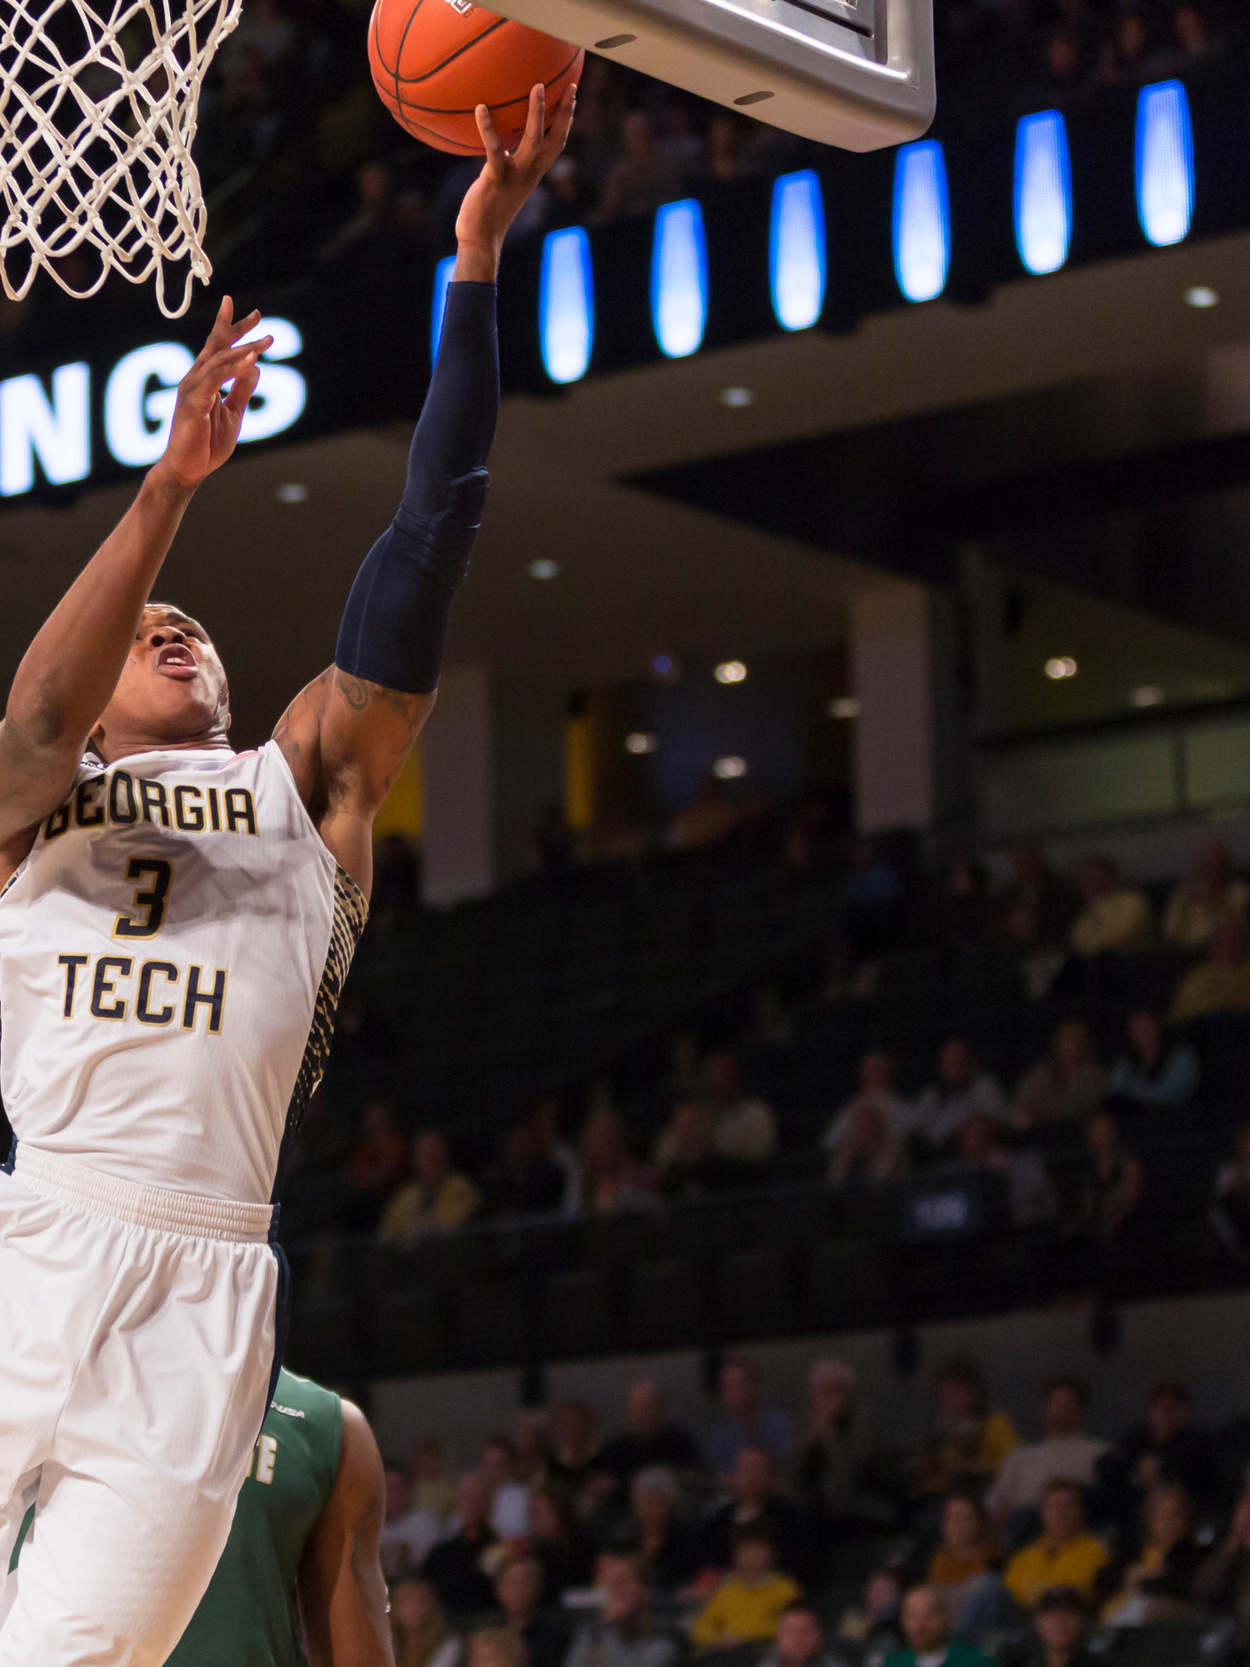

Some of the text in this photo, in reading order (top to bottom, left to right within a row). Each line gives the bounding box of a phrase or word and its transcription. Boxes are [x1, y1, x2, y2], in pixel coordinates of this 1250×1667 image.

[111, 856, 173, 939] 3
[57, 954, 228, 1035] TECH
[247, 1435, 277, 1484] E
